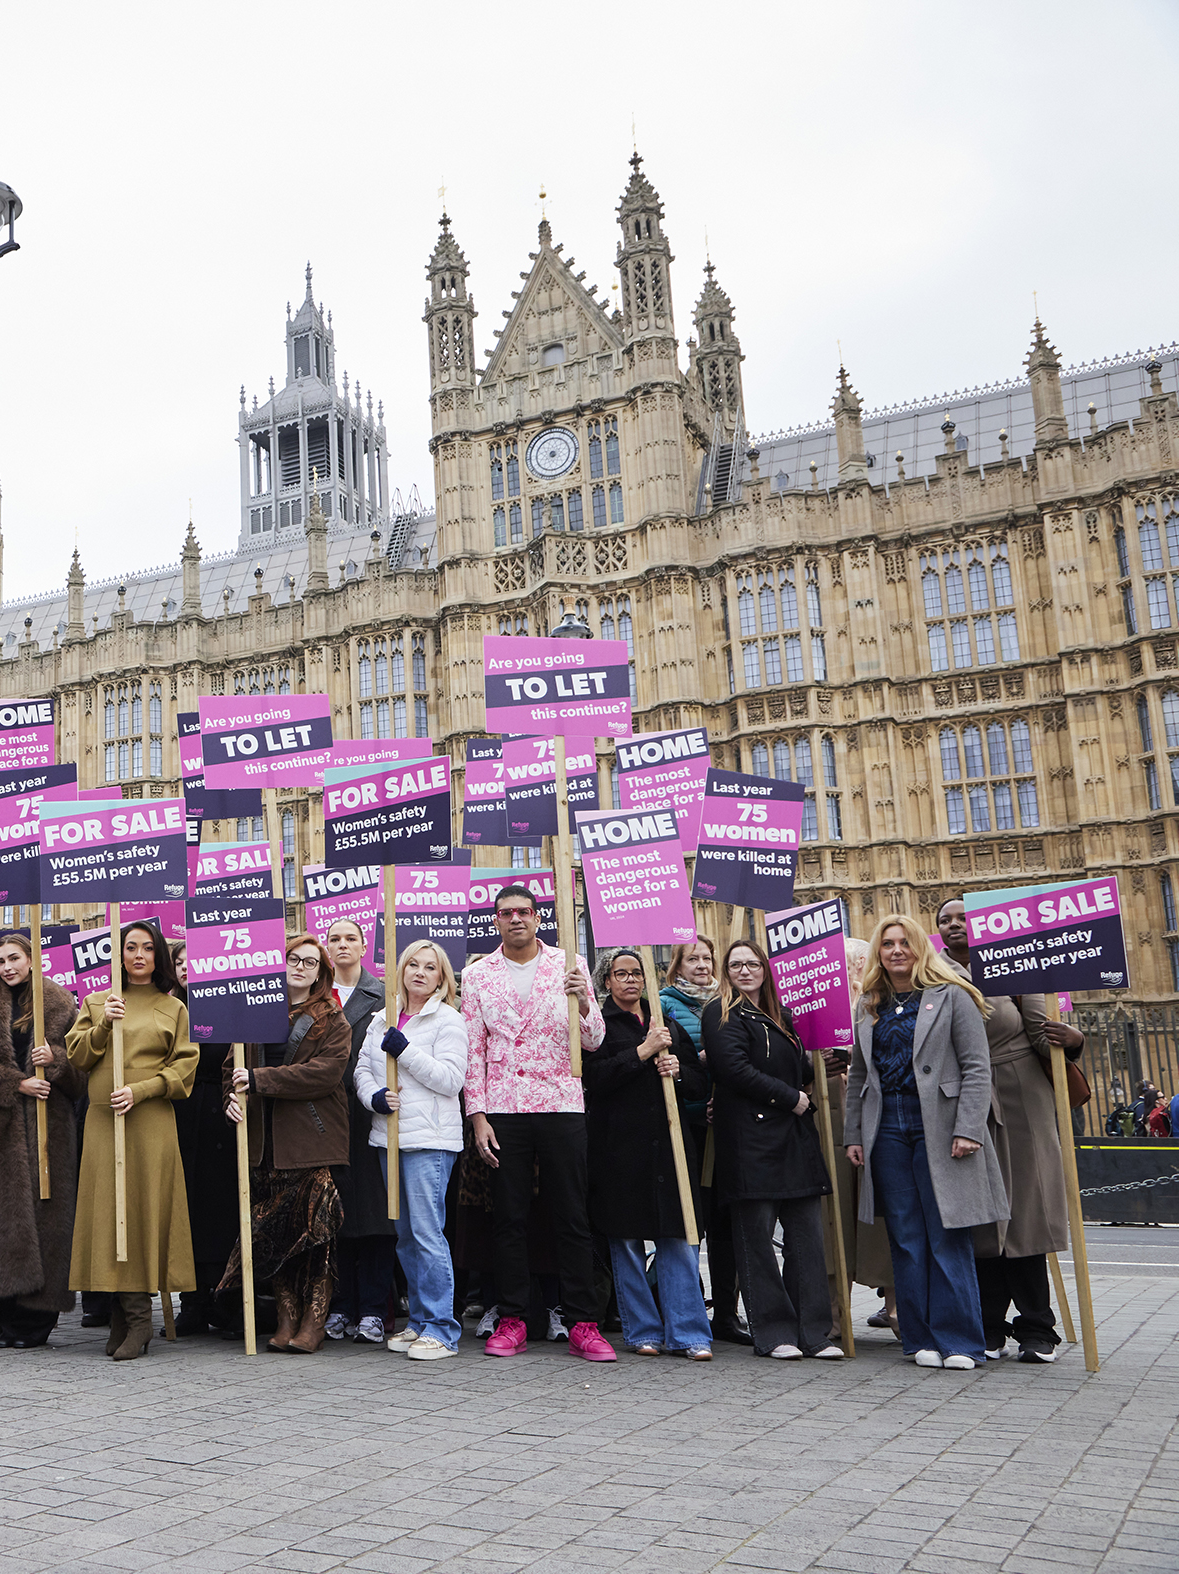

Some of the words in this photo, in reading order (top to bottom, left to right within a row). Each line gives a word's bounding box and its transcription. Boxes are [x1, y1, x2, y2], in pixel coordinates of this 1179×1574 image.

[489, 658, 512, 669] Are
[516, 658, 541, 669] you
[544, 653, 584, 667] going
[506, 677, 547, 700] TO
[555, 672, 606, 696] LET
[205, 718, 226, 728] Are
[228, 715, 252, 727] you
[254, 709, 290, 724] going
[531, 708, 557, 720] this
[560, 702, 626, 717] continue?
[608, 721, 628, 729] Refuge
[9, 733, 37, 744] most
[220, 734, 258, 757] TO
[265, 725, 311, 751] LET
[244, 762, 268, 774] this
[270, 752, 330, 770] continue?
[328, 783, 378, 812] FOR
[385, 765, 446, 798] SALE
[714, 782, 739, 793] Last
[743, 786, 772, 796] year
[332, 814, 386, 834] Women's
[389, 806, 426, 822] safety
[737, 803, 767, 822] 75
[44, 820, 104, 847] FOR
[112, 806, 182, 836] SALE
[335, 831, 380, 850] £55.5M
[383, 828, 403, 842] per
[406, 821, 433, 838] year
[581, 813, 676, 848] HOME
[704, 824, 796, 843] women
[50, 850, 114, 869] Women's
[117, 845, 159, 859] safety
[590, 858, 620, 870] The
[623, 850, 661, 865] most
[702, 851, 735, 860] were
[738, 850, 774, 863] killed
[778, 855, 791, 864] at
[54, 868, 106, 886] £55.5M
[110, 866, 133, 880] per
[136, 861, 167, 876] year
[596, 864, 678, 884] dangerous
[754, 864, 792, 876] home
[600, 885, 642, 902] place
[644, 880, 666, 892] for
[670, 880, 679, 888] a
[698, 882, 716, 891] Refuge
[193, 910, 220, 922] Last
[223, 908, 252, 922] year
[604, 897, 661, 913] woman
[970, 907, 1032, 939] FOR
[1038, 886, 1114, 923] SALE
[220, 928, 251, 950] 75
[768, 904, 841, 952] HOME
[978, 939, 1044, 961] Women's
[1047, 930, 1092, 948] safety
[190, 950, 282, 974] women
[775, 960, 796, 974] The
[798, 947, 827, 967] most
[984, 957, 1038, 978] £55.5M
[1040, 954, 1065, 970] per
[1068, 946, 1102, 964] year
[778, 960, 841, 989] dangerous
[192, 987, 226, 998] were
[229, 979, 266, 994] killed
[268, 978, 282, 989] at
[246, 993, 284, 1005] home
[781, 987, 812, 1006] place
[814, 980, 830, 993] for
[834, 977, 841, 986] a
